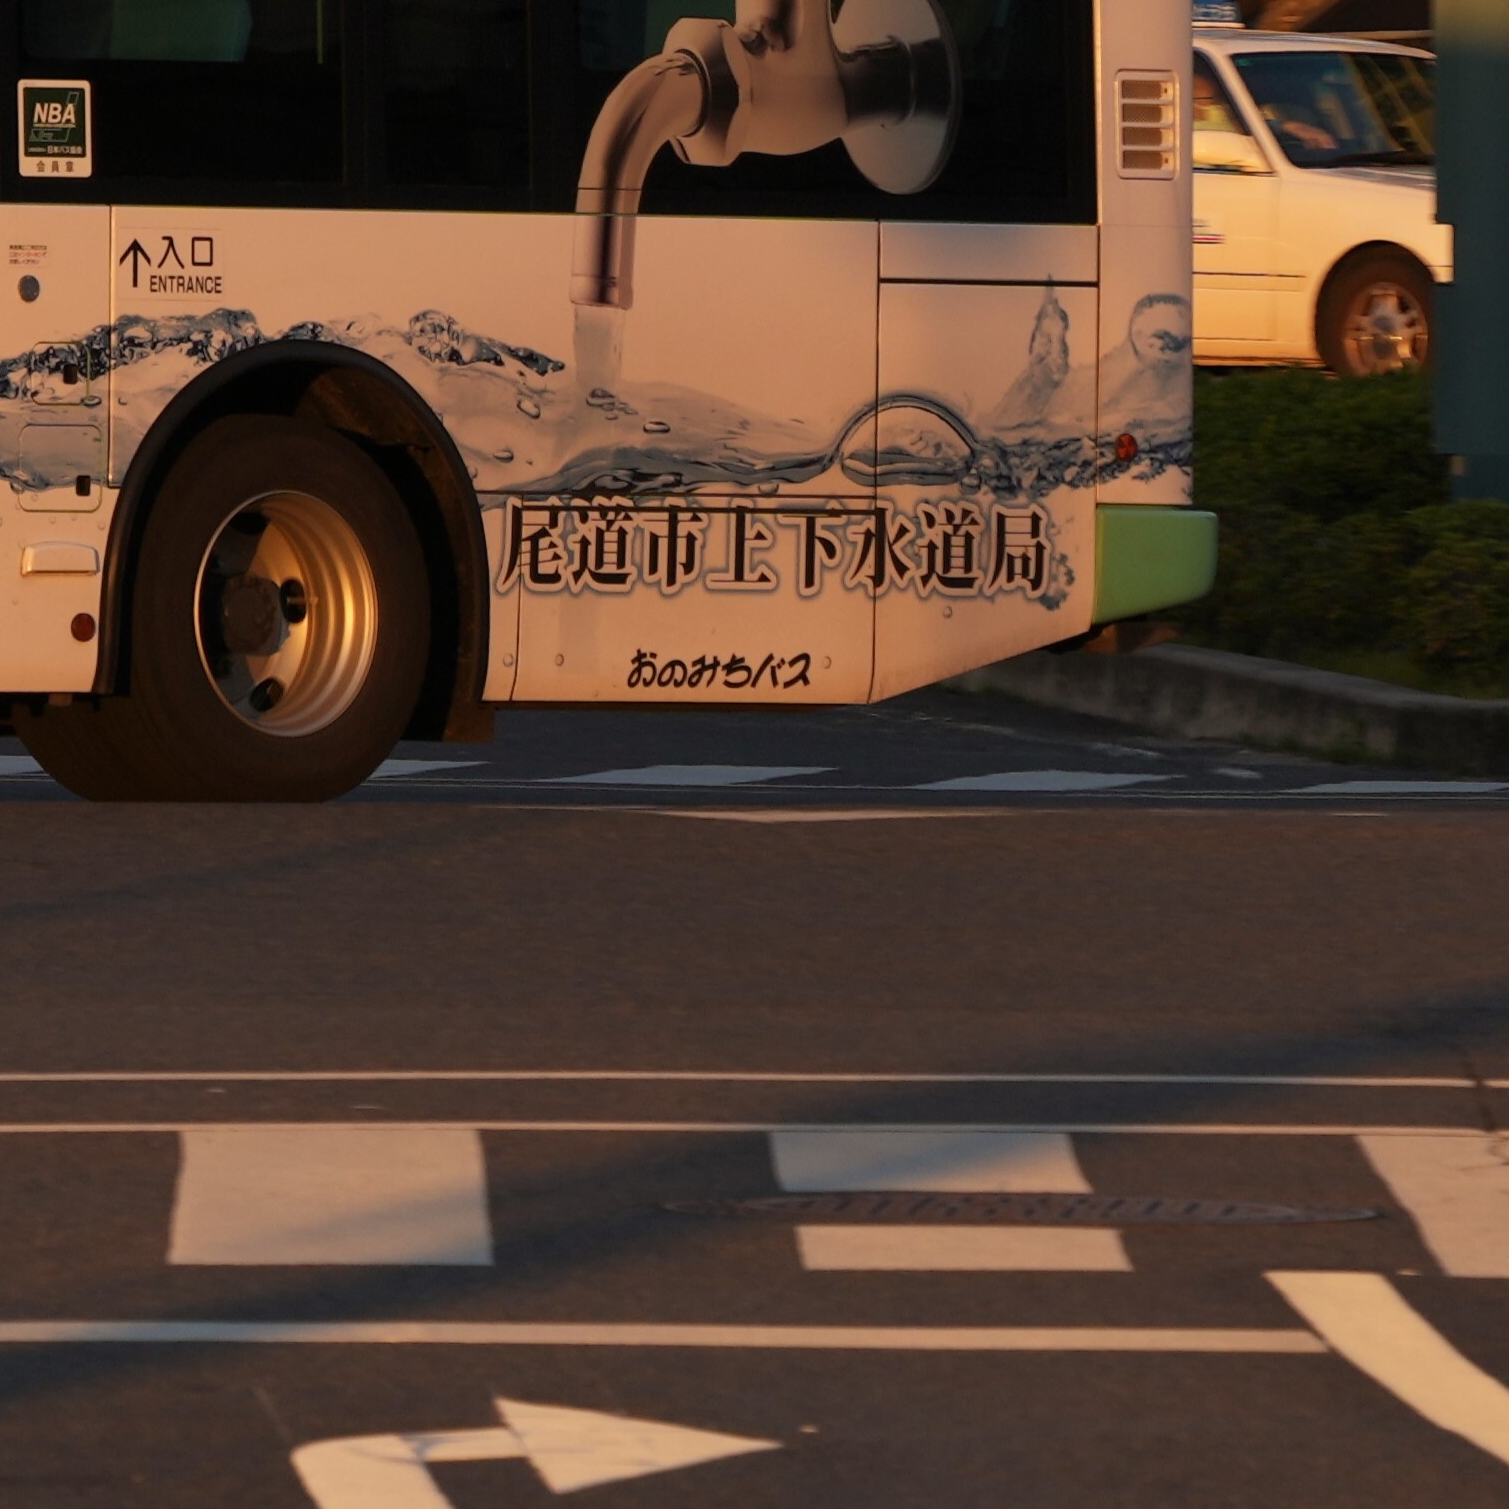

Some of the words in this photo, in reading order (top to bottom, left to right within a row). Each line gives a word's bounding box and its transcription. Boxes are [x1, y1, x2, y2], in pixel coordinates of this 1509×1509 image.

[33, 103, 77, 124] NBA
[157, 236, 214, 268] 入口
[150, 275, 222, 293] ENTRANCE
[500, 503, 1047, 589] 尾道市上下水道局
[627, 648, 812, 689] おのみちバス
